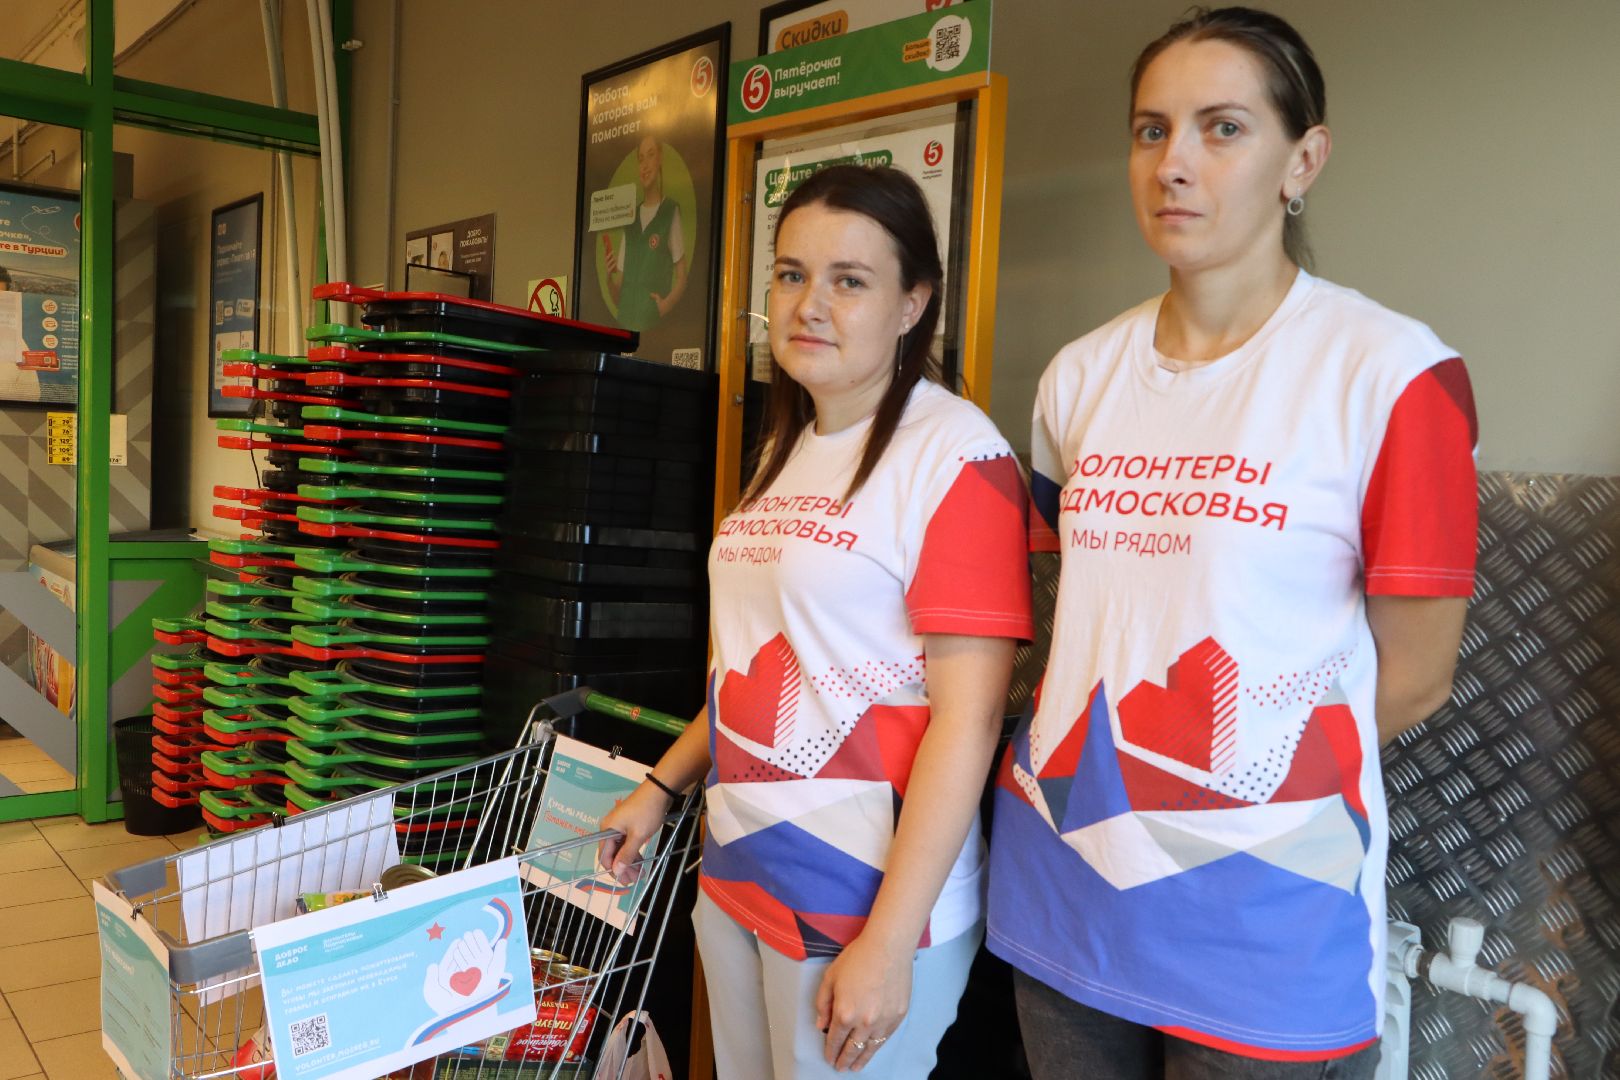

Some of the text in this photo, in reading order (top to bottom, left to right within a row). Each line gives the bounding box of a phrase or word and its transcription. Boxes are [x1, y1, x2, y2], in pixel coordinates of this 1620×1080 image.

[782, 17, 842, 49] Скидки
[774, 55, 842, 82] Пятёрочка
[774, 71, 841, 99] выручает!
[592, 96, 658, 125] которая вам
[591, 120, 641, 144] помогает
[20, 244, 65, 256] Турции!
[740, 495, 854, 519] ОЛОНТЕРЫ
[1061, 487, 1288, 531] ДМОСКОВЬЯ
[719, 518, 859, 551] ДМОСКОВЬЯ
[1071, 529, 1192, 557] МЫ РЯДОМ
[717, 546, 783, 566] МЫ РЯДОМ
[274, 944, 308, 962] ДОБРОЕ
[275, 956, 299, 969] ДЕЛО
[532, 1018, 573, 1031] ГЛАЗУР
